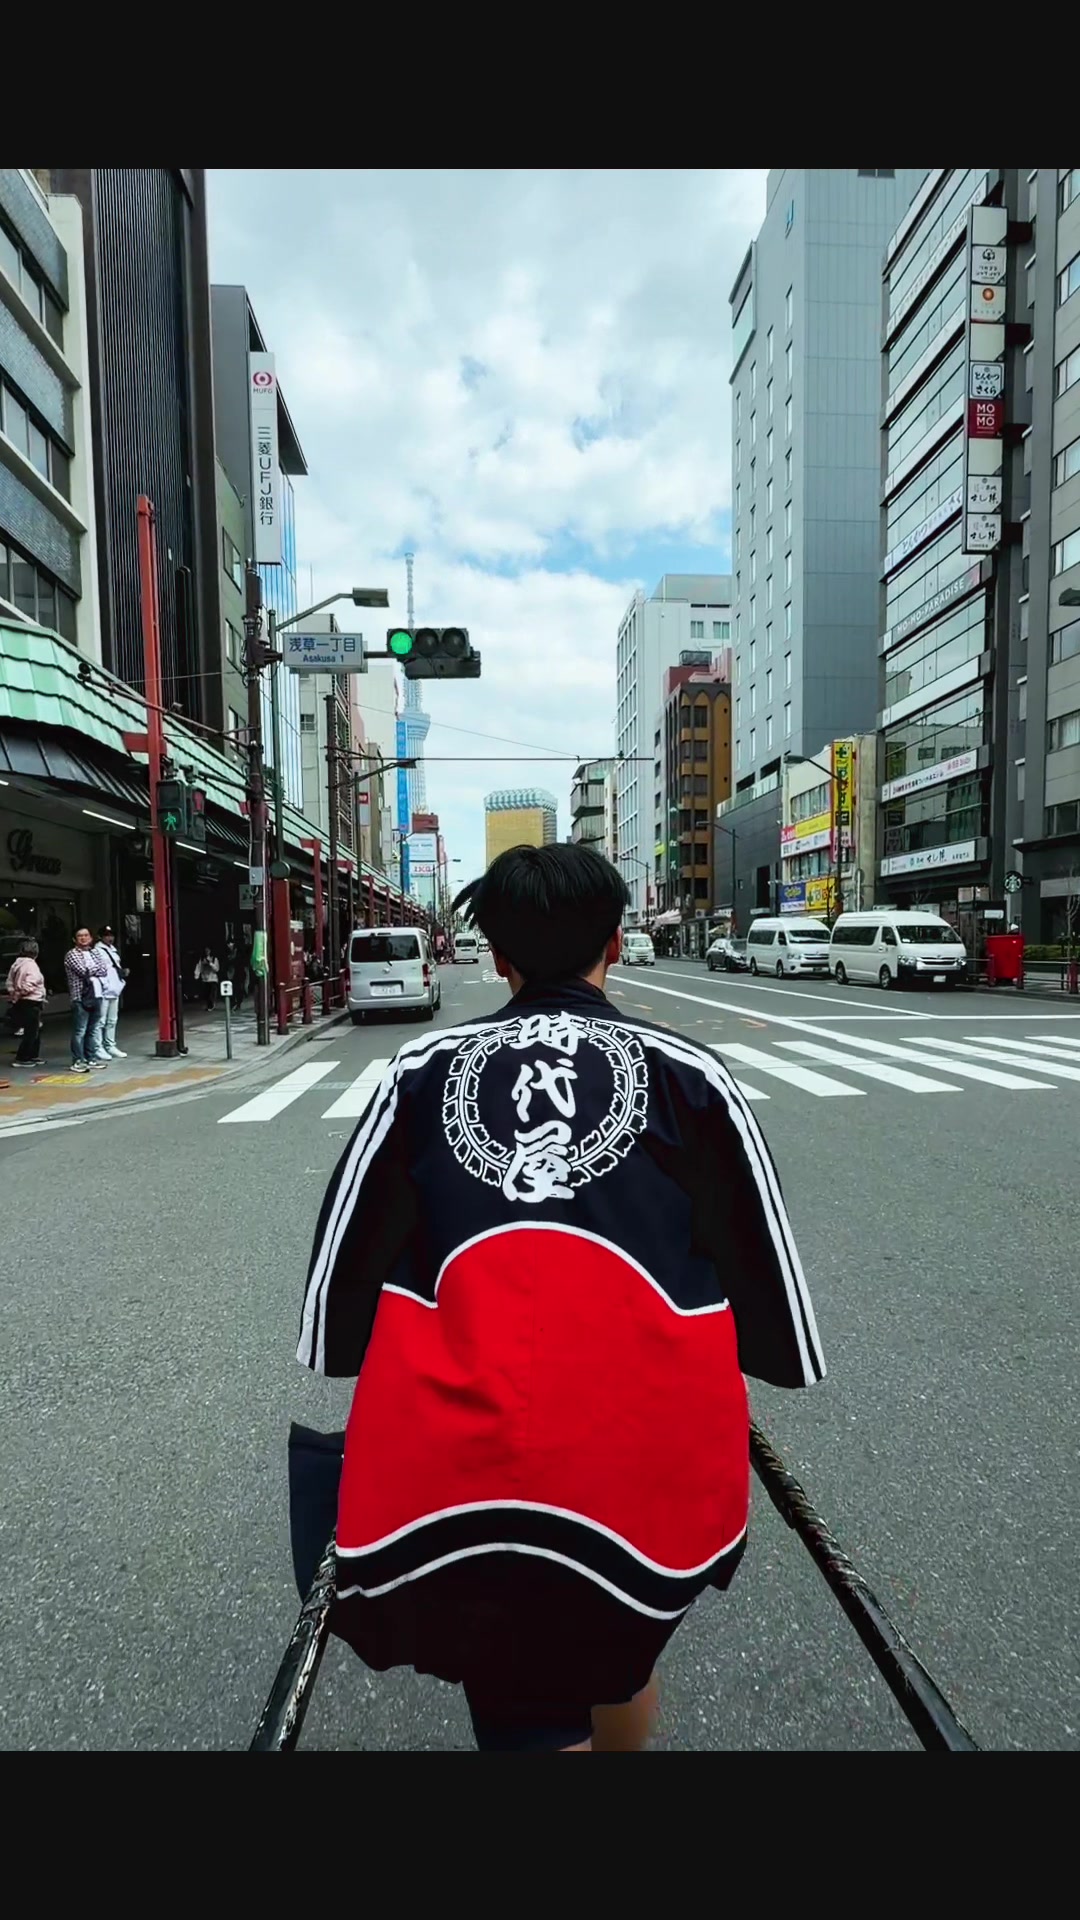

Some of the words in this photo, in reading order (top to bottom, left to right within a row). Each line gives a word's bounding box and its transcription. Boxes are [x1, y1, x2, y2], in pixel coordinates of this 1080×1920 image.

[976, 385, 997, 395] さくら
[976, 403, 995, 413] MO
[976, 416, 995, 426] MO
[257, 426, 274, 526] 三菱UFJ銀行
[289, 637, 356, 652] 浅草一丁目
[303, 654, 336, 663] Asakusa
[340, 654, 344, 663] 1
[502, 1010, 588, 1203] 時代屋
